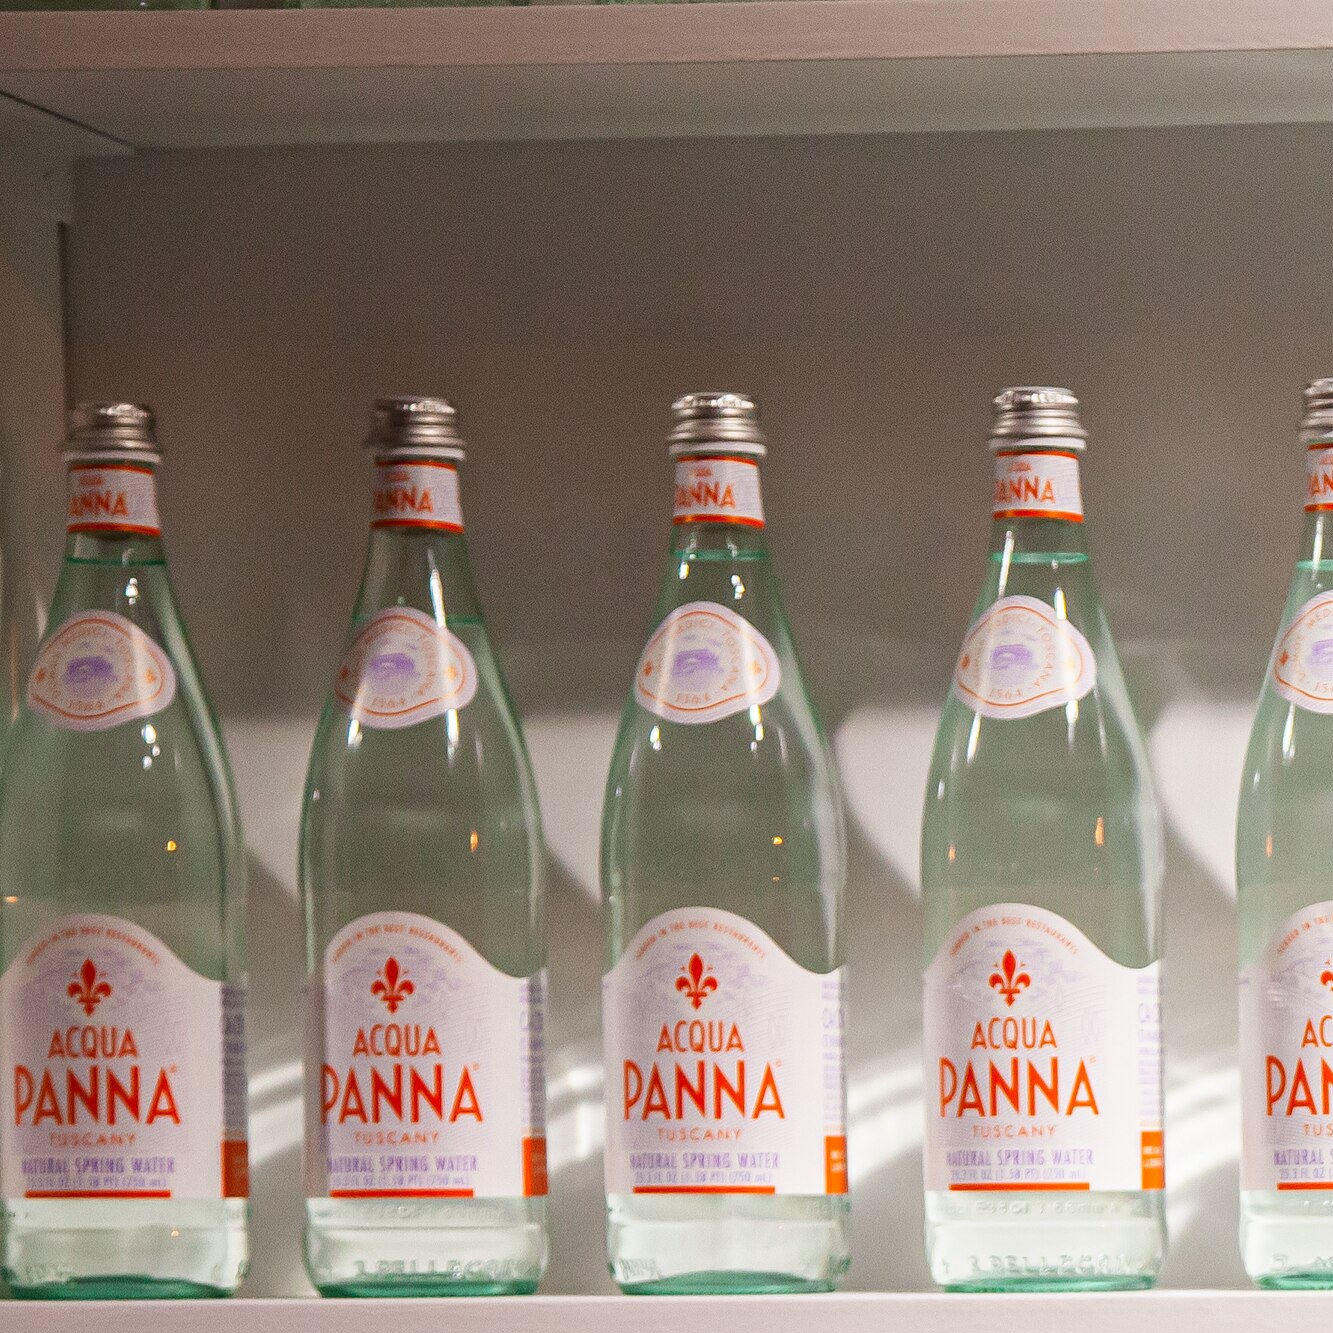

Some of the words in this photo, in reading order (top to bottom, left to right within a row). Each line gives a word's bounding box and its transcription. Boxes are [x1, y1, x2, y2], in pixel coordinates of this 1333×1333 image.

[50, 1028, 137, 1059] ACQUA
[354, 1024, 440, 1057] ACQUA
[658, 1021, 743, 1053] ACQUA
[972, 1017, 1056, 1049] ACQUA
[15, 1066, 181, 1125] PANNA
[323, 1064, 483, 1124] PANNA
[624, 1060, 784, 1120] PANNA
[940, 1057, 1099, 1117] PANNA
[1272, 1149, 1327, 1166] NATURAL
